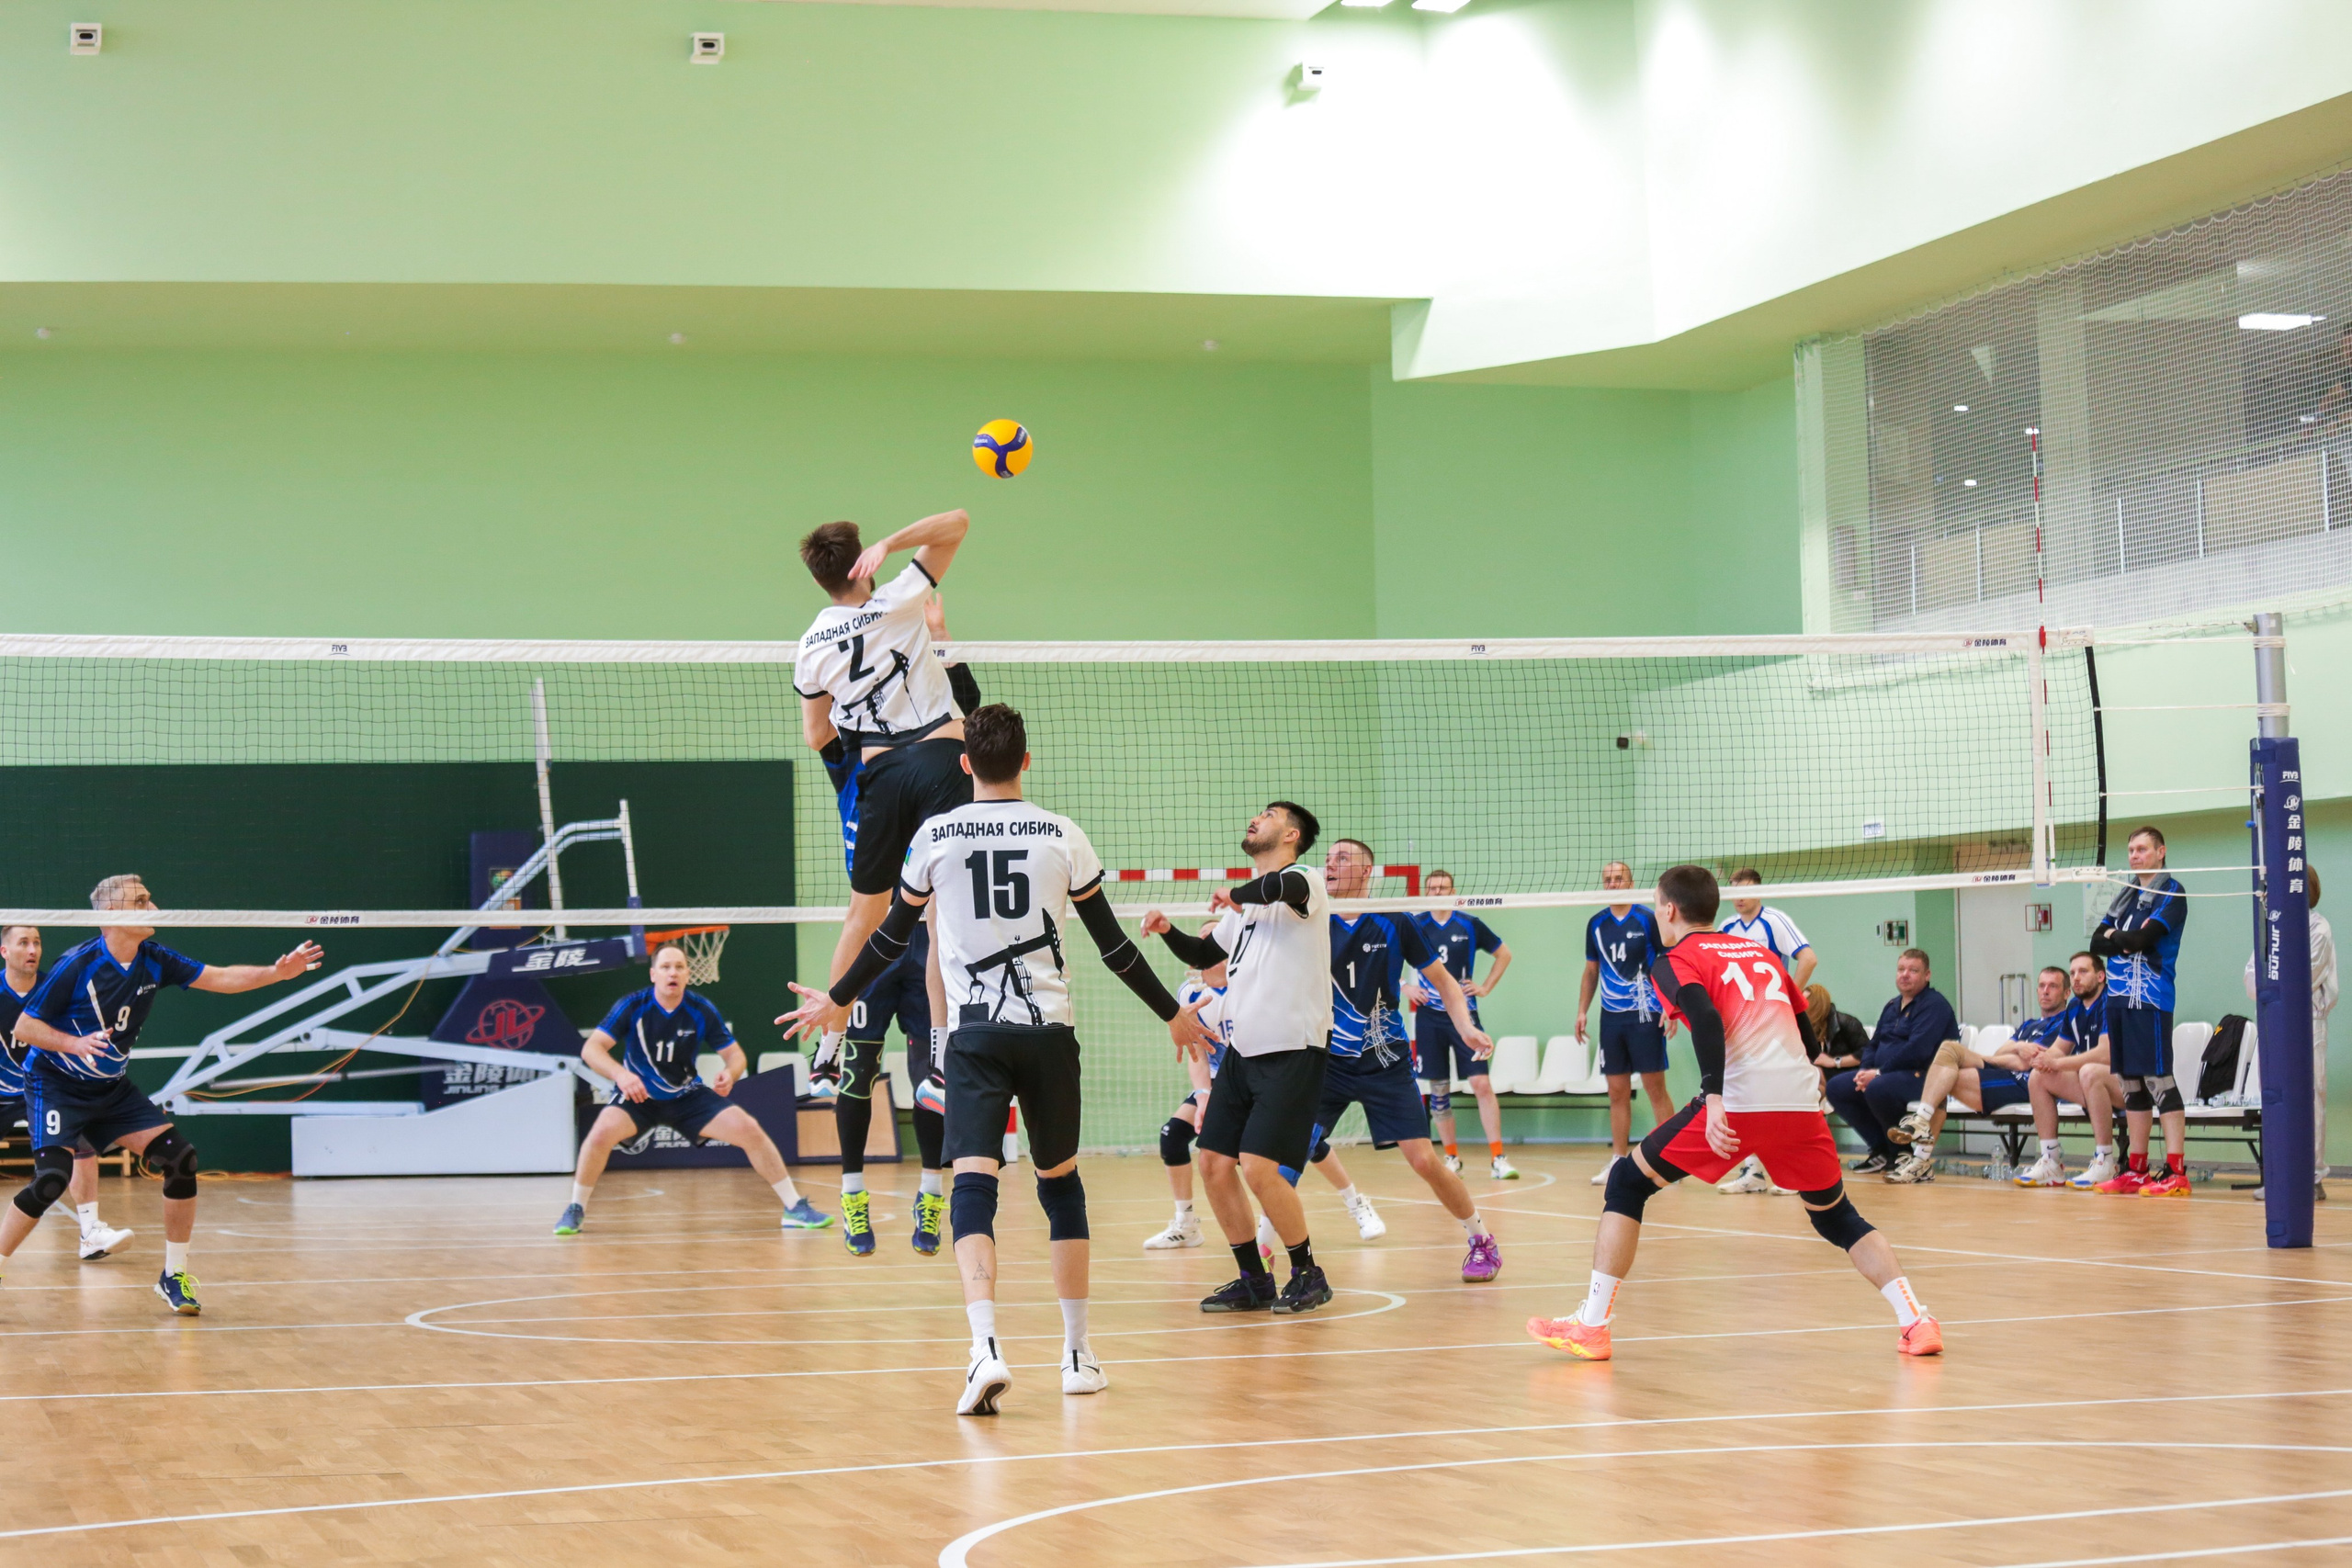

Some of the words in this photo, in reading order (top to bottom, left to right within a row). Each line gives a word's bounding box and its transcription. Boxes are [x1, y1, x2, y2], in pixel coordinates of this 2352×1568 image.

[806, 622, 851, 649] ЗАПАДНАЯ
[1471, 644, 1486, 652] FIVB
[837, 634, 876, 683] 2
[2282, 771, 2299, 780] FIVB
[932, 822, 1004, 842] ЗАПАДНАЯ
[1010, 821, 1063, 838] СИБИРЬ
[2287, 815, 2303, 894] 金陵体育
[965, 849, 1030, 920] 15
[525, 947, 586, 969] 金陵
[1438, 944, 1448, 964] 3
[1610, 942, 1627, 963] 14
[2271, 924, 2280, 980] JINLING
[1346, 961, 1356, 988] 1
[1720, 961, 1792, 1005] 12
[115, 1005, 131, 1032] 9
[1217, 1019, 1234, 1041] 15
[656, 1041, 675, 1062] 11
[46, 1110, 61, 1135] 9
